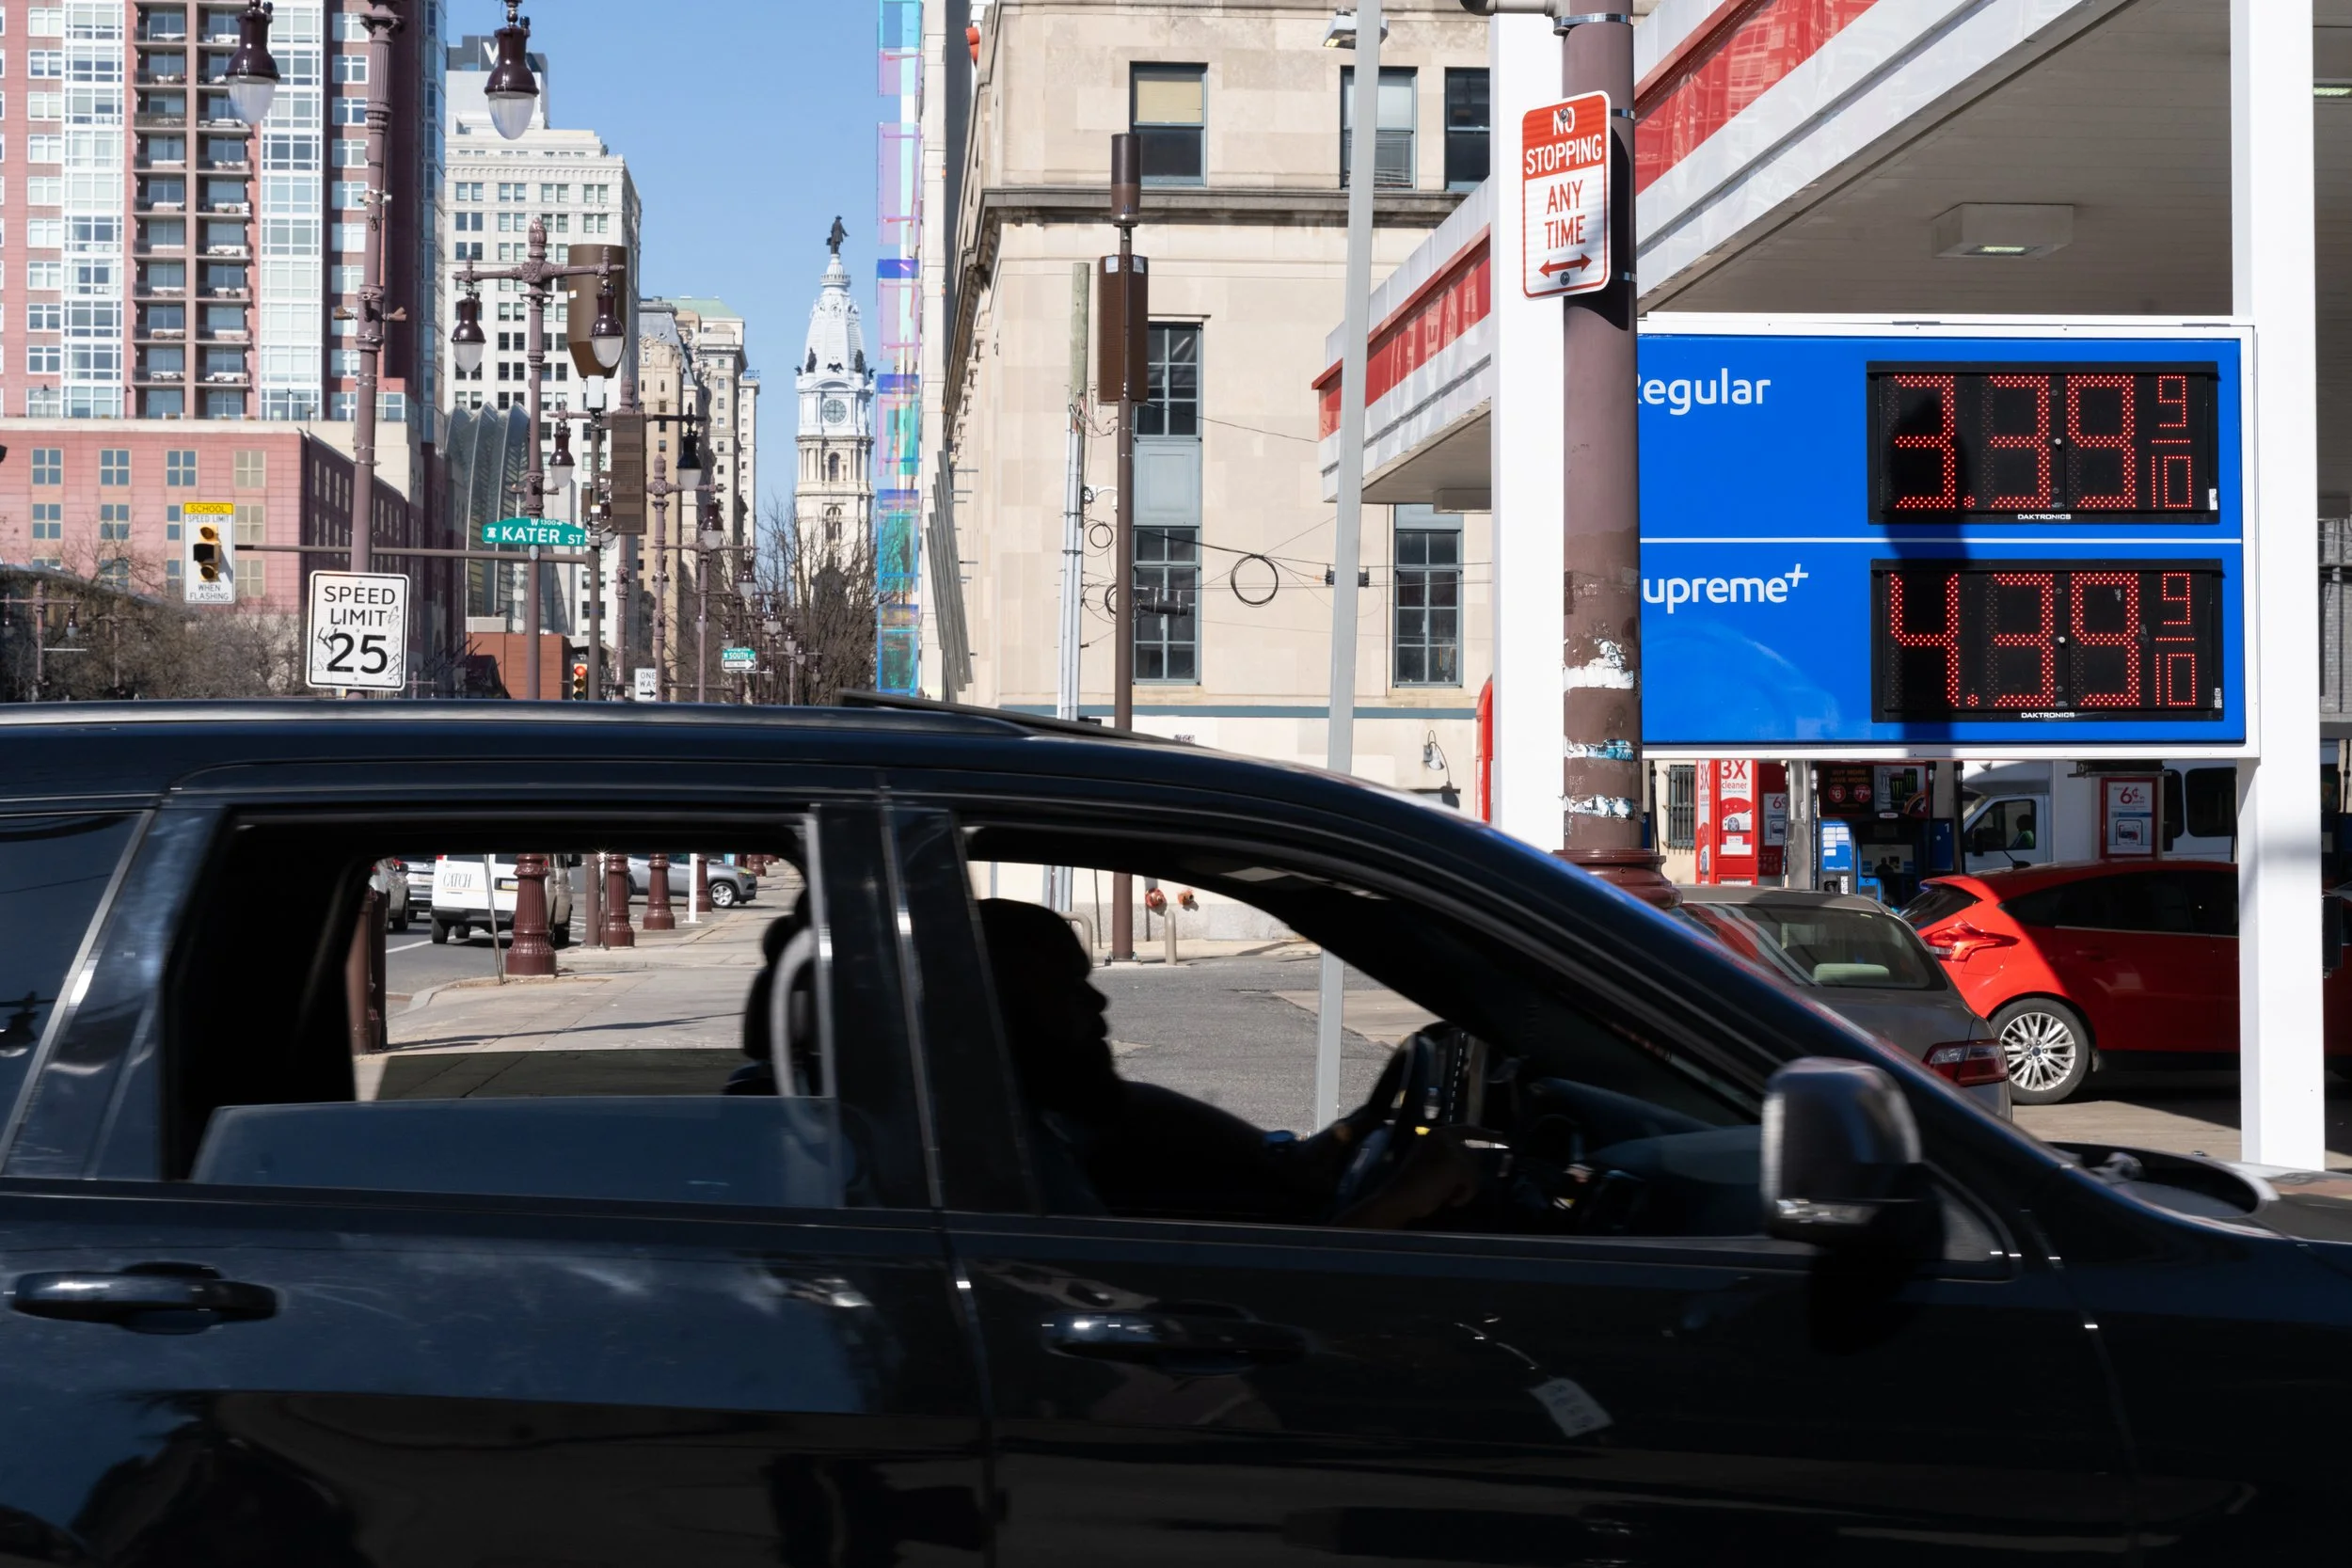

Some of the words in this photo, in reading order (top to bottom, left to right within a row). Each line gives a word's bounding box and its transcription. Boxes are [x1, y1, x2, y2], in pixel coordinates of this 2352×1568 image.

[1552, 106, 1575, 135] NO
[1525, 134, 1602, 175] STOPPING
[1547, 179, 1583, 215] ANY
[1544, 214, 1586, 250] TIME
[188, 515, 210, 523] SPEED
[213, 515, 230, 523] LIMIT
[191, 505, 227, 514] SCHOOL
[501, 527, 561, 544] KATER
[567, 534, 582, 545] ST
[324, 585, 396, 605] SPEED
[330, 608, 388, 627] LIMIT
[326, 632, 388, 674] 25
[1721, 760, 1747, 780] 3X
[1721, 781, 1747, 789] cleaner
[1944, 822, 1950, 833] 1
[443, 873, 472, 888] CATCH
